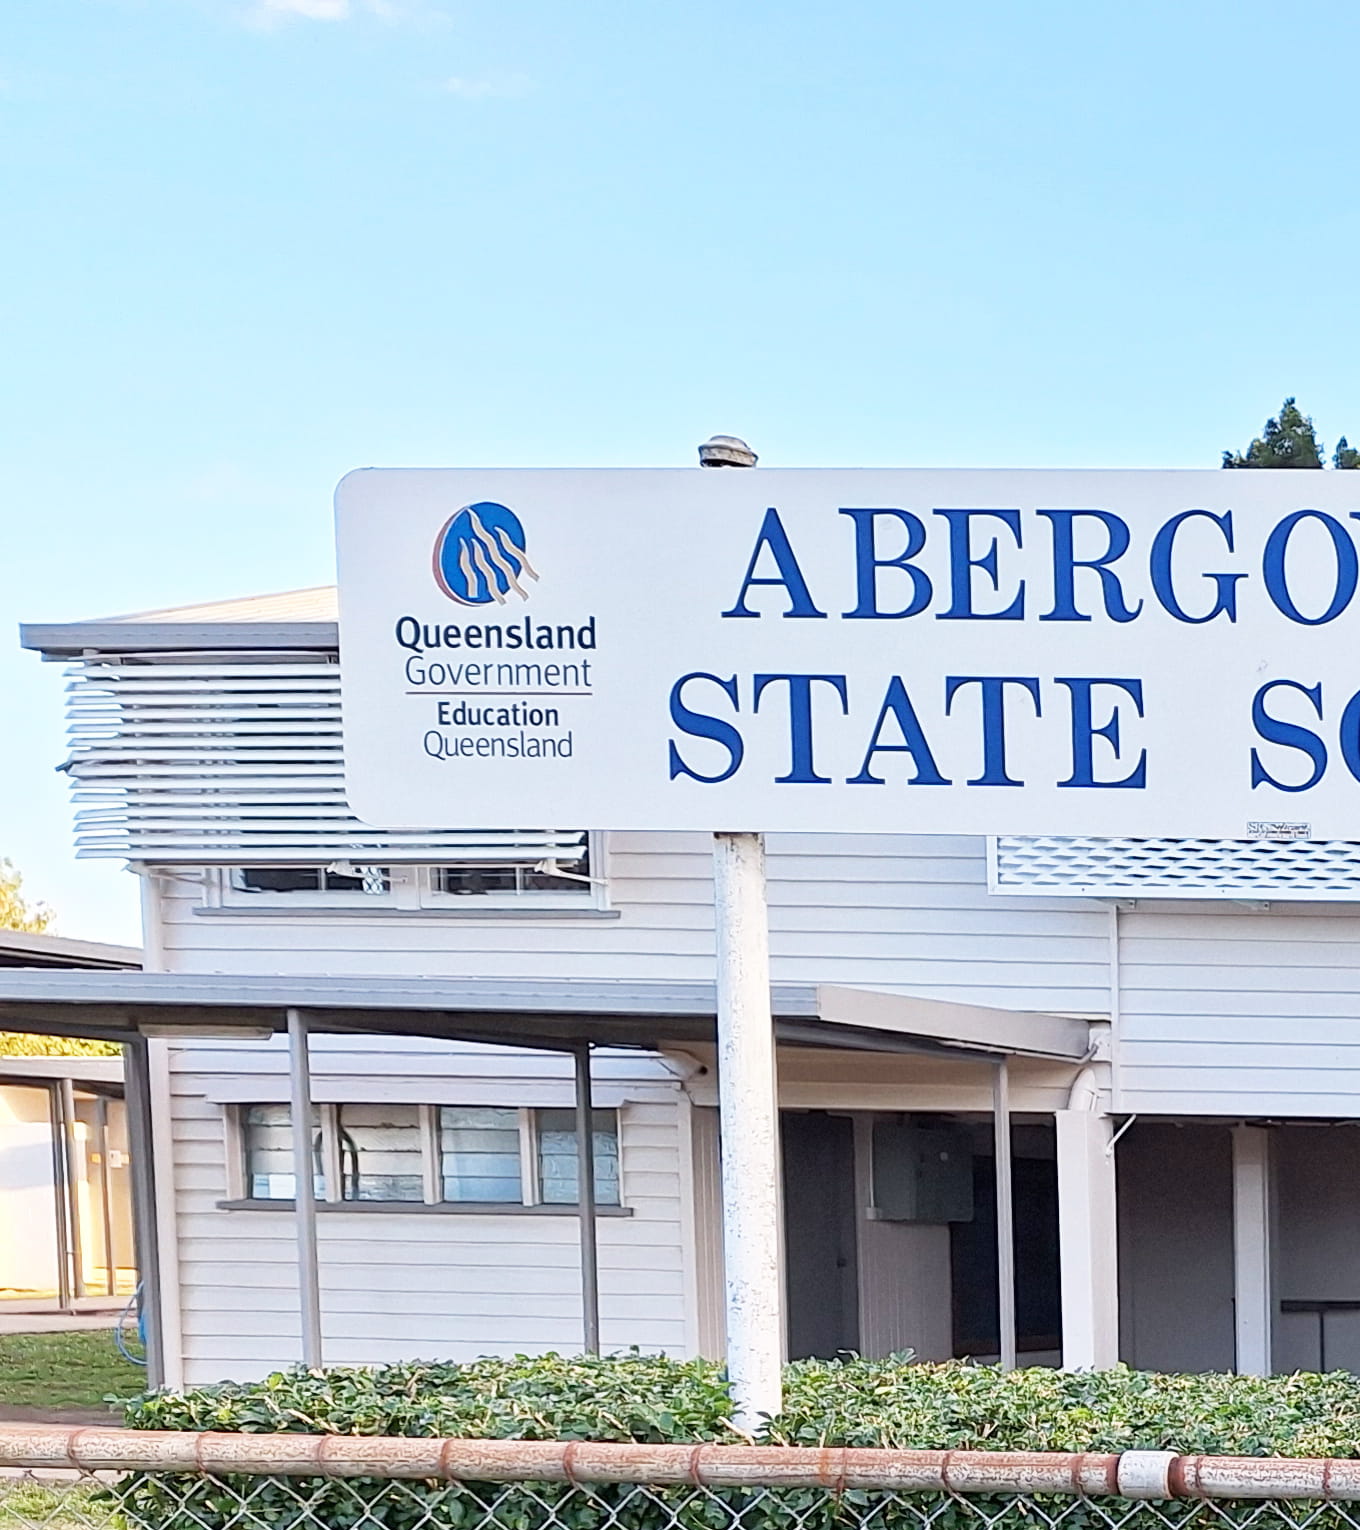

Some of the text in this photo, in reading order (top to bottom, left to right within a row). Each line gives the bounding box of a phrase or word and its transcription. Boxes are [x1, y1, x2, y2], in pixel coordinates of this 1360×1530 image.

[395, 615, 597, 653] Queensland
[405, 655, 593, 688] Government
[437, 700, 559, 727] Education
[423, 730, 573, 761] Queensland
[668, 671, 1147, 790] STATE
